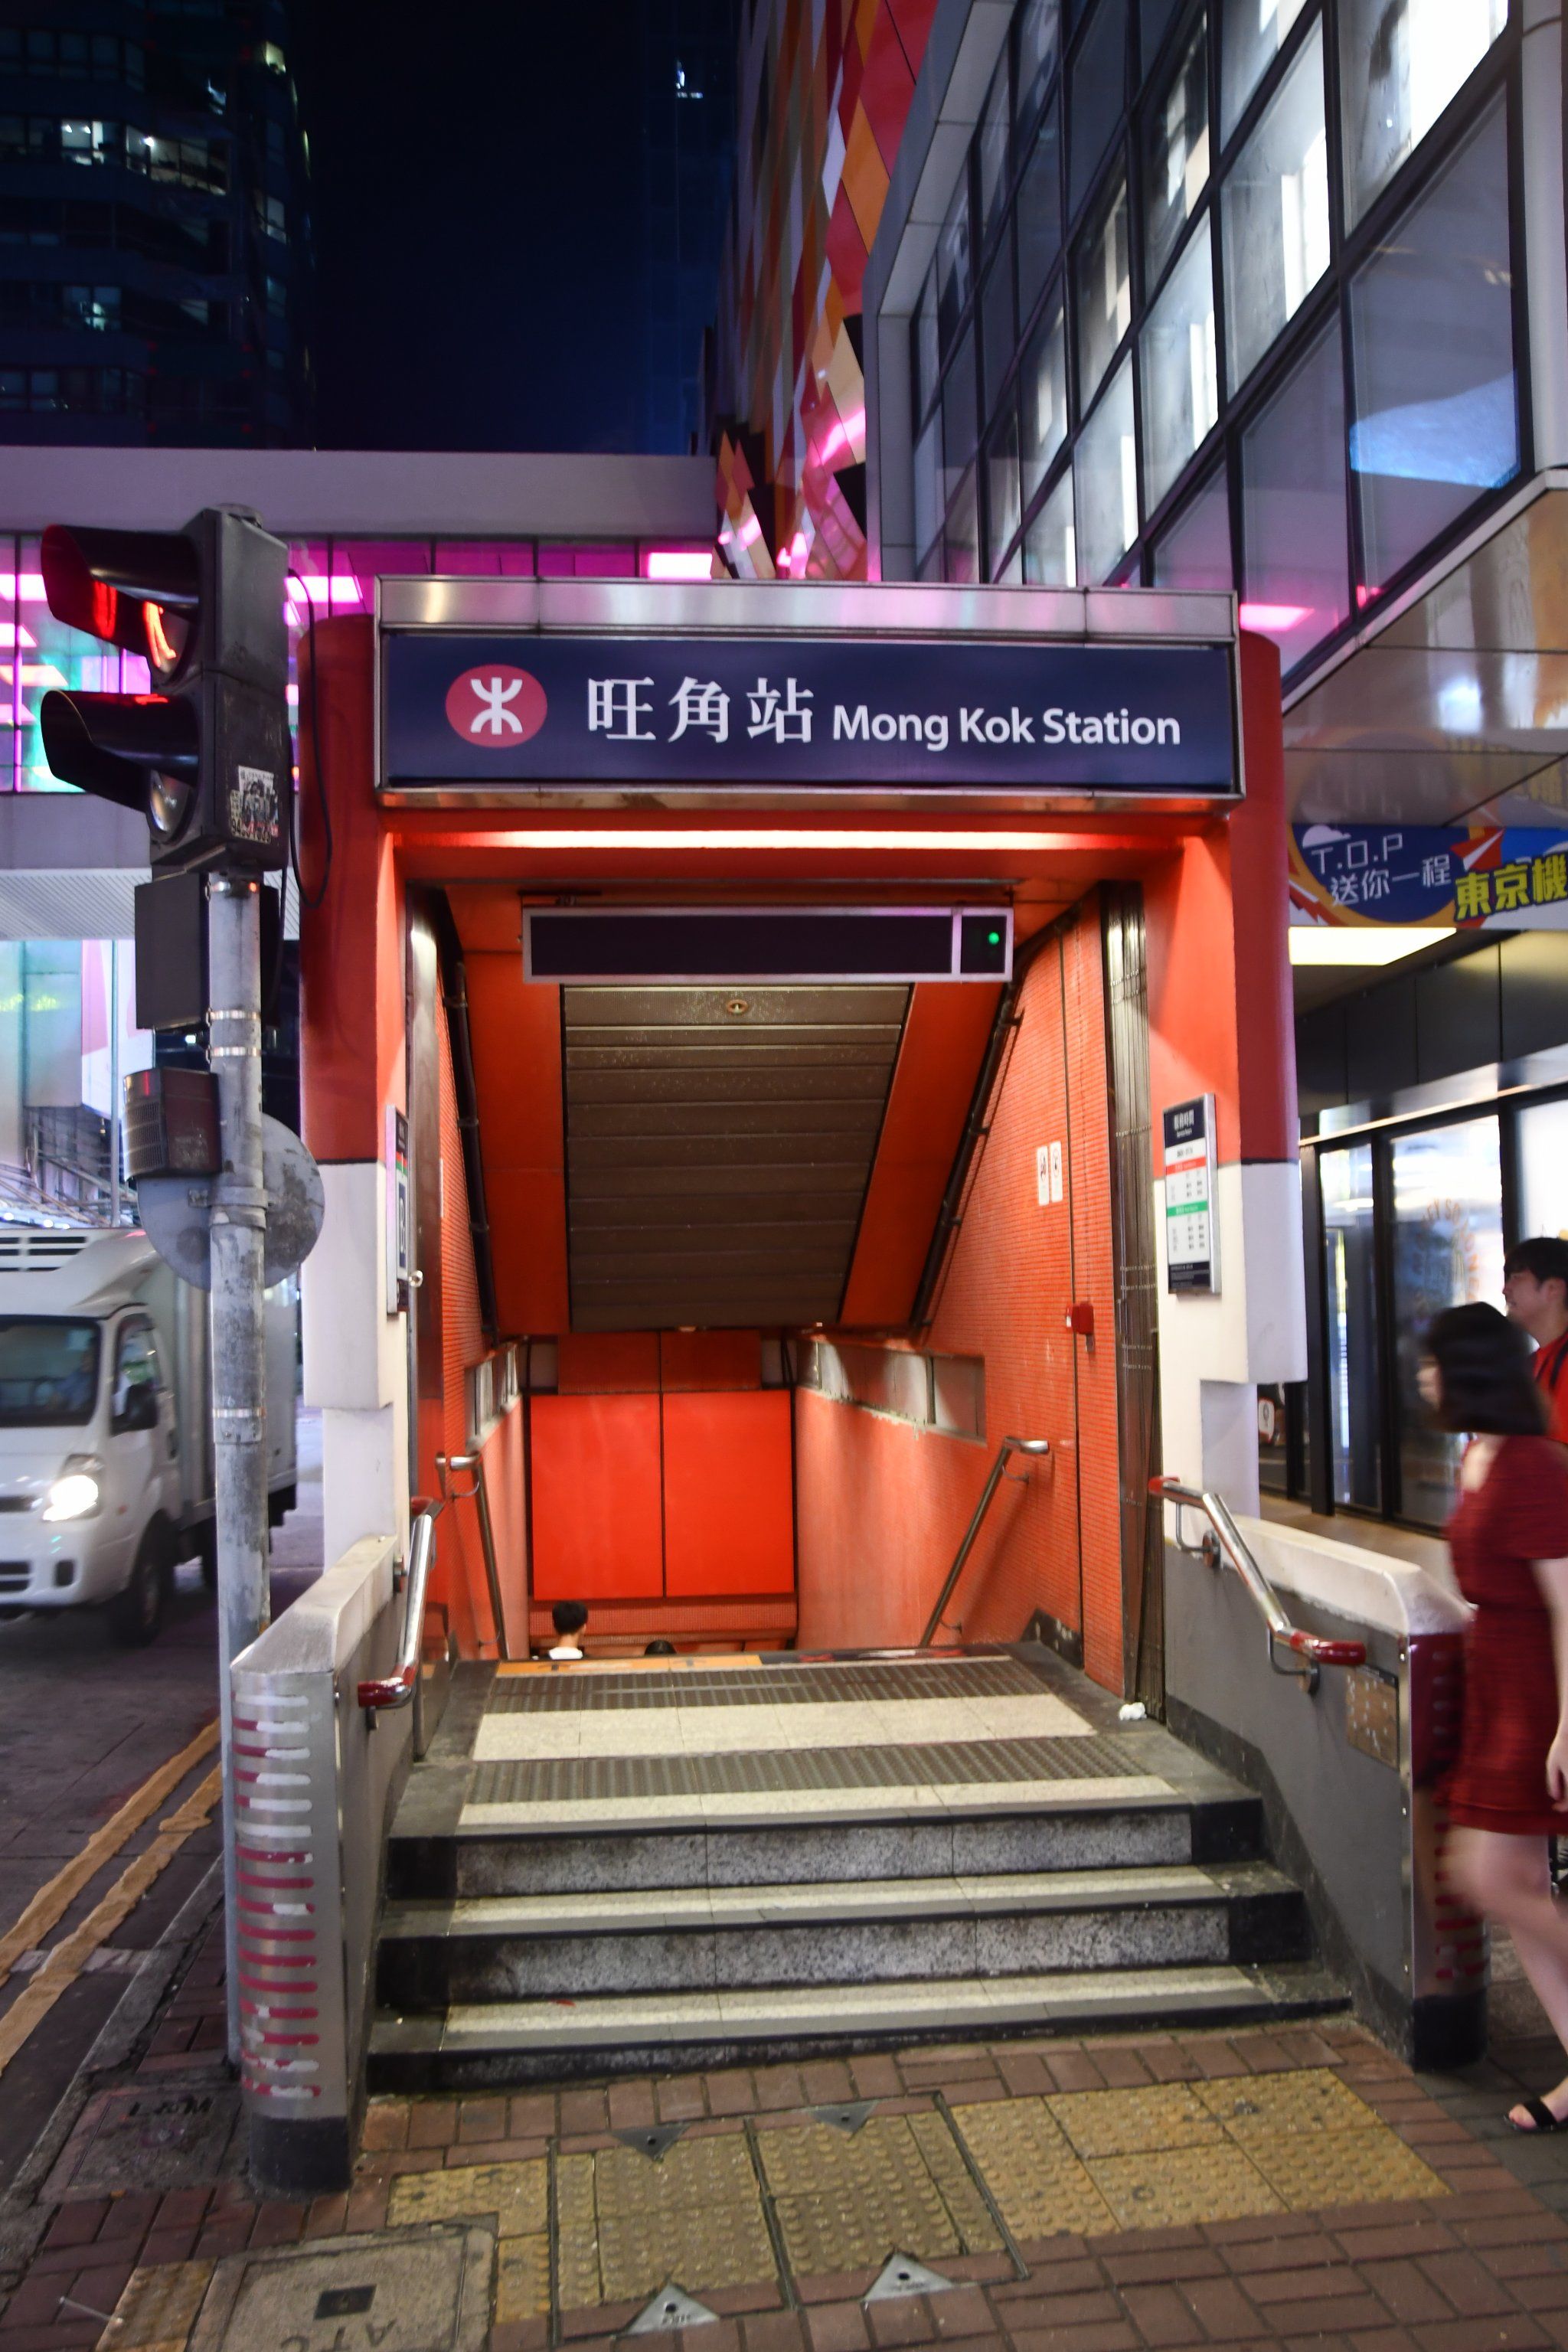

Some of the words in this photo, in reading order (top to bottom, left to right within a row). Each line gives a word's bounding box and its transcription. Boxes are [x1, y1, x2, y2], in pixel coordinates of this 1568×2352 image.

[588, 675, 815, 743] 旺角站
[832, 704, 949, 752] Mong
[959, 706, 1035, 743] Kok
[1043, 706, 1181, 745] Station
[1330, 853, 1452, 906] 送你一程
